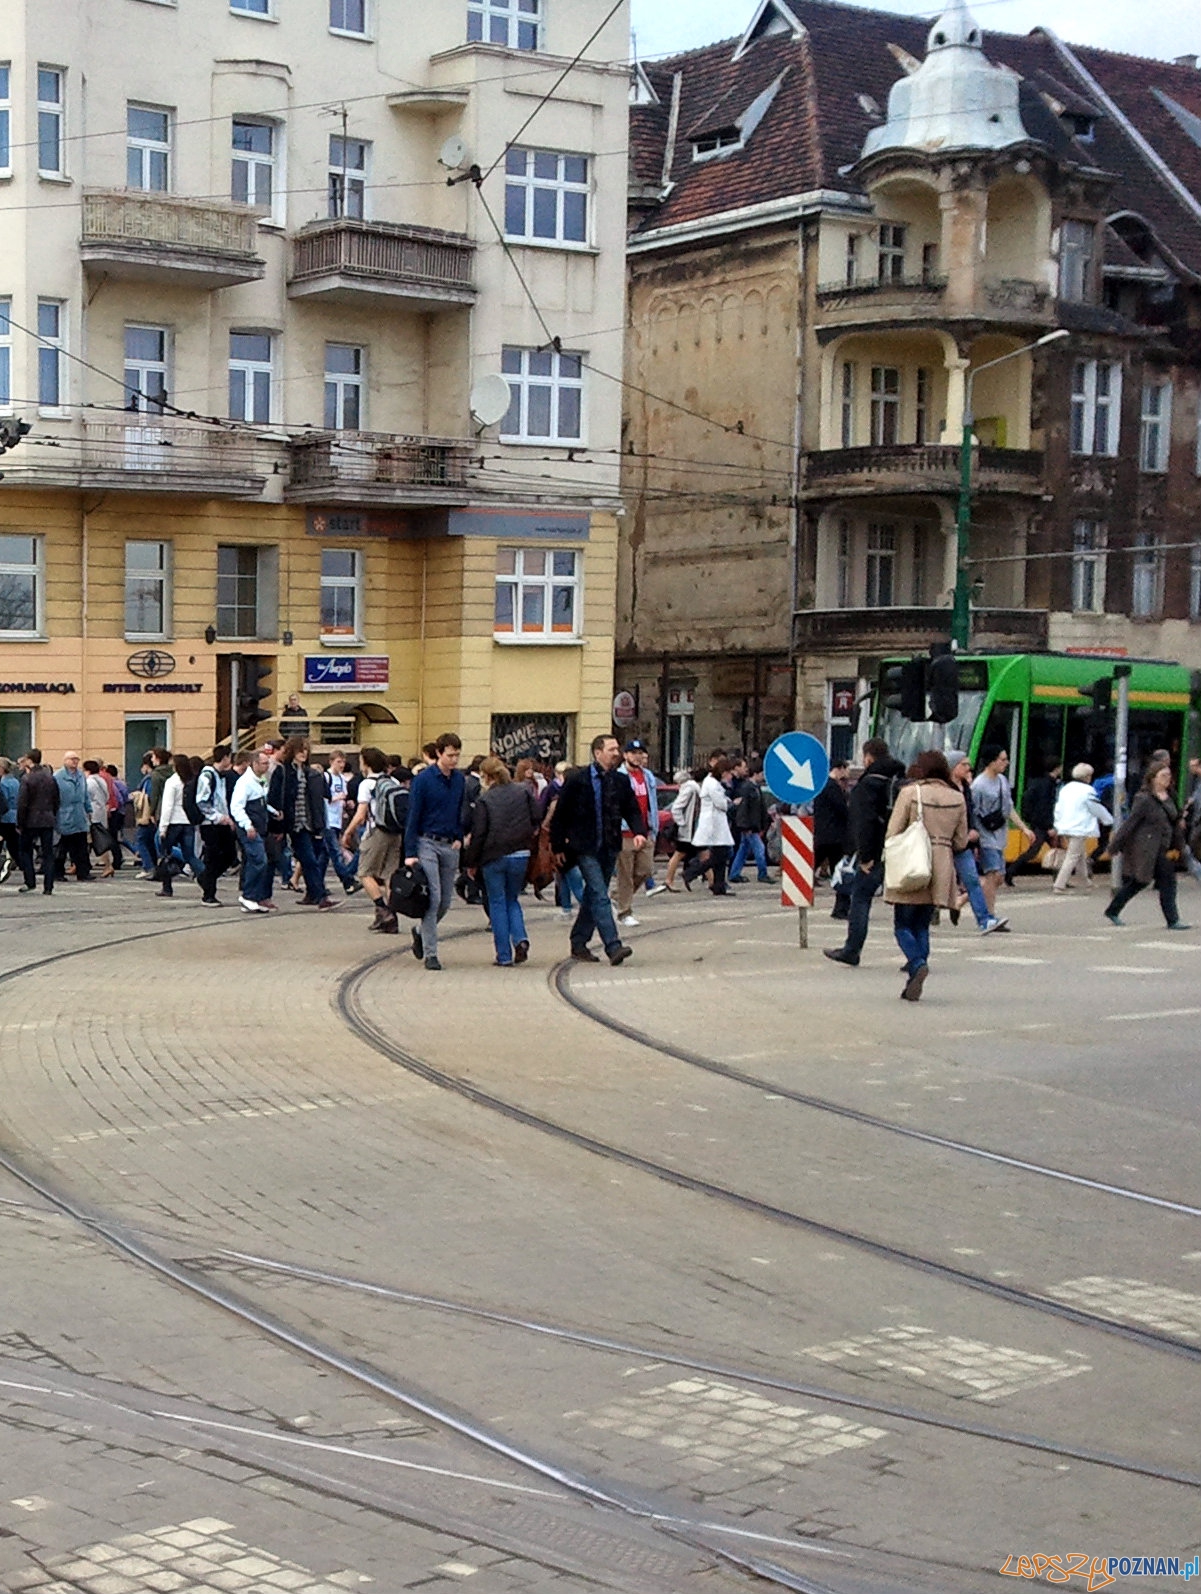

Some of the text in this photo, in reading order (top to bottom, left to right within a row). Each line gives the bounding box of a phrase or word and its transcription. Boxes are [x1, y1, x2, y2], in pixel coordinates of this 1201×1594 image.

[103, 683, 203, 693] INTER CONSULT
[492, 722, 537, 753] NOWE
